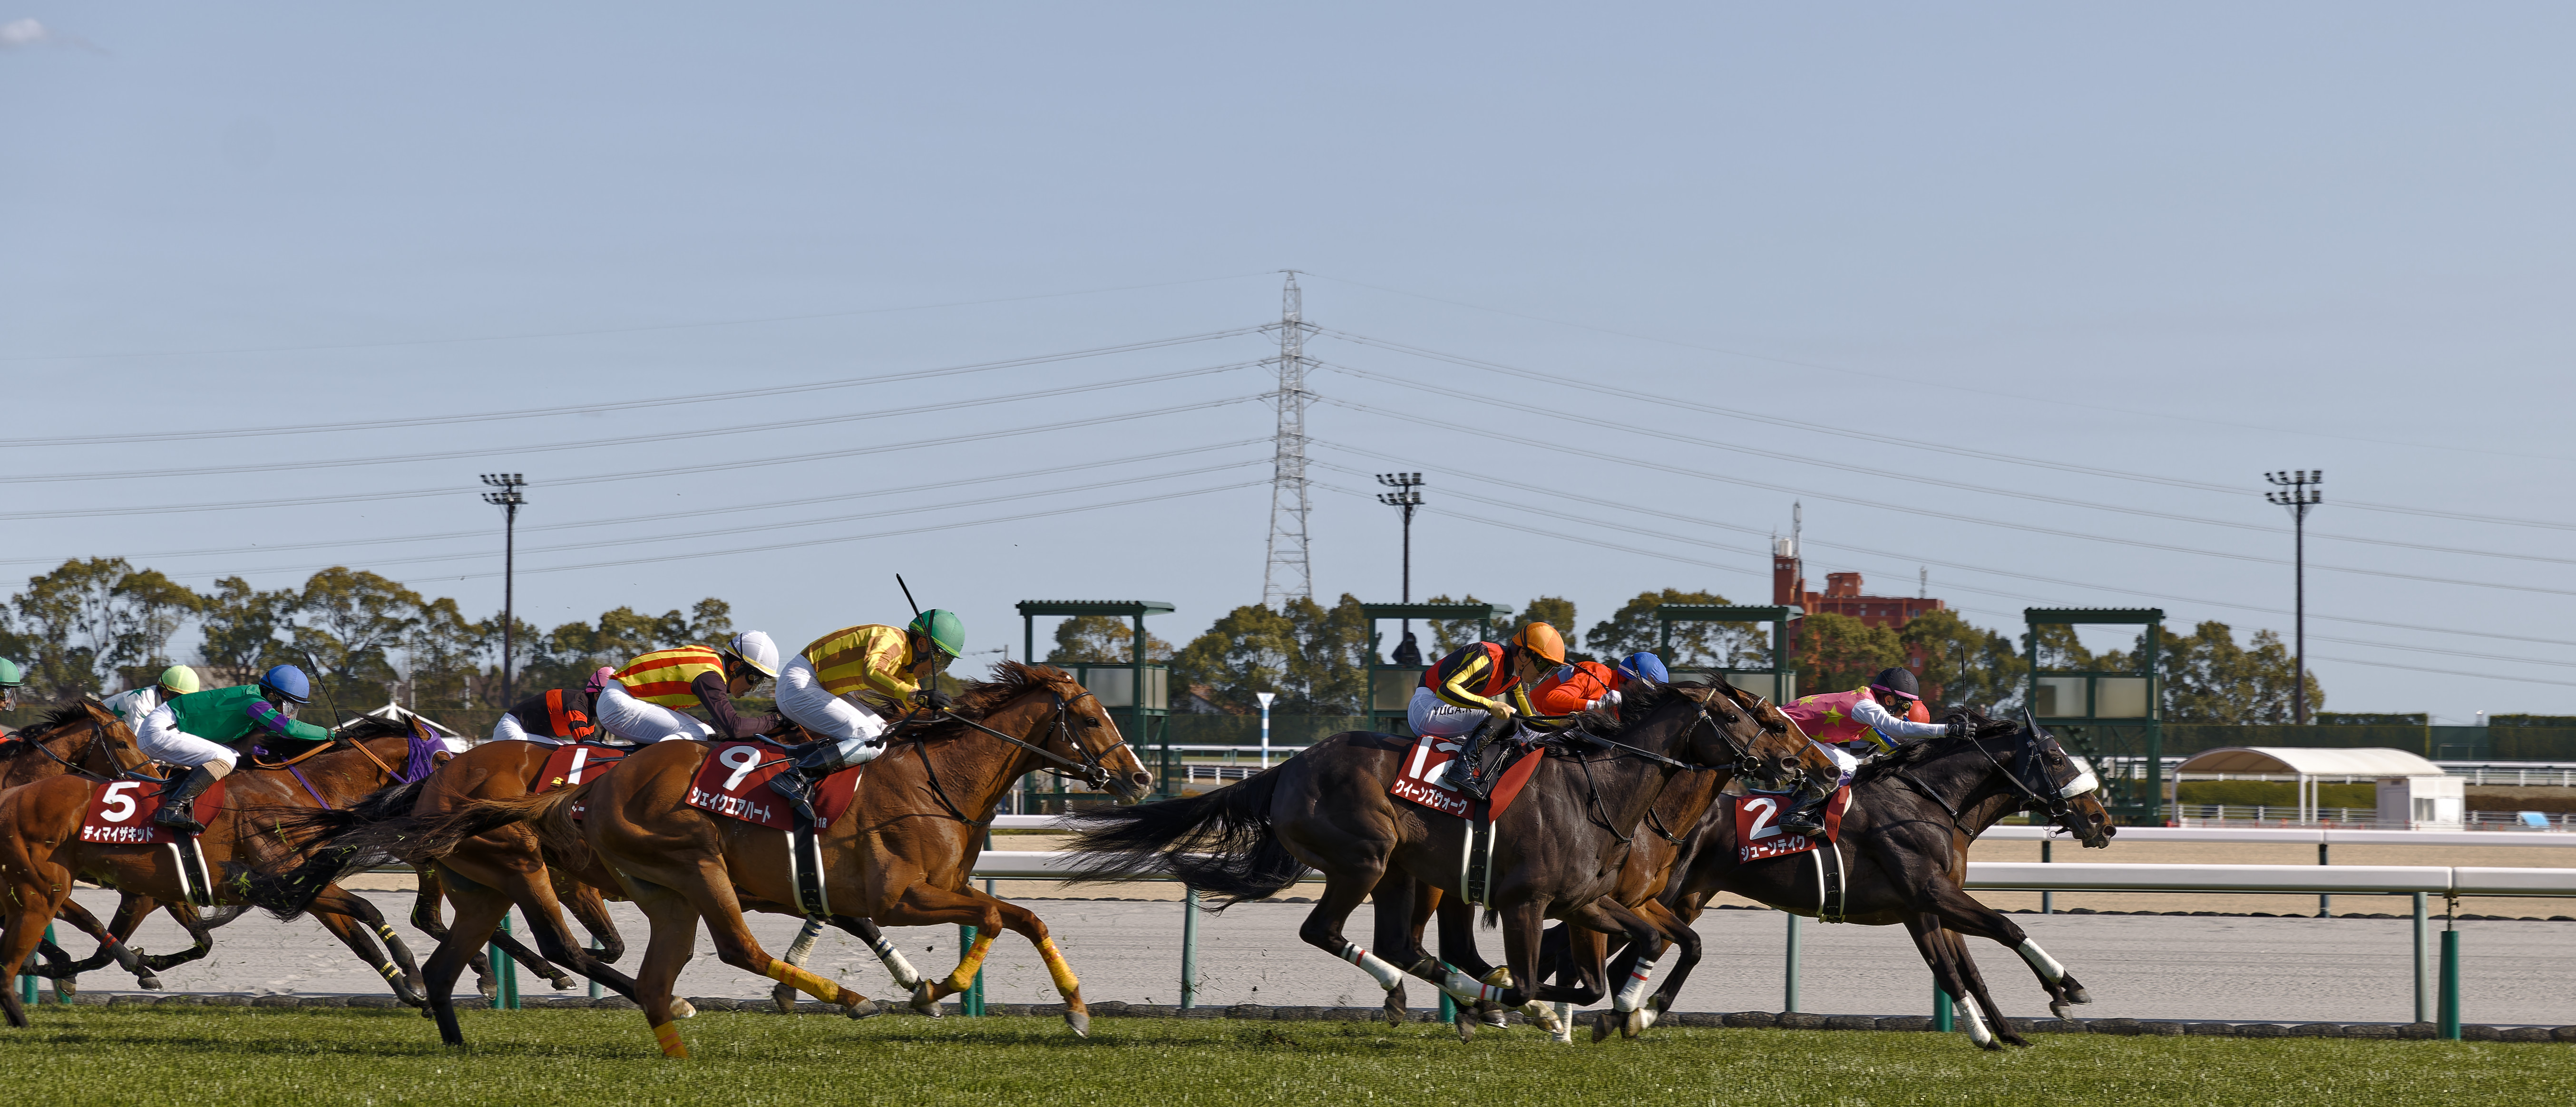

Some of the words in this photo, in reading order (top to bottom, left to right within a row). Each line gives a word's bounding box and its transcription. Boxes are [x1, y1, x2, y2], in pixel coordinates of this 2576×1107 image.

[567, 748, 589, 785] 1
[719, 745, 761, 791] 9
[1409, 736, 1463, 792] 12
[100, 781, 141, 822] 5
[691, 786, 771, 823] シェイクユアハート
[1395, 779, 1468, 815] クイーンズウォーク
[84, 825, 154, 842] ディマイザキッド
[1743, 797, 1782, 840] 2
[1741, 835, 1805, 862] ジューンテイク
